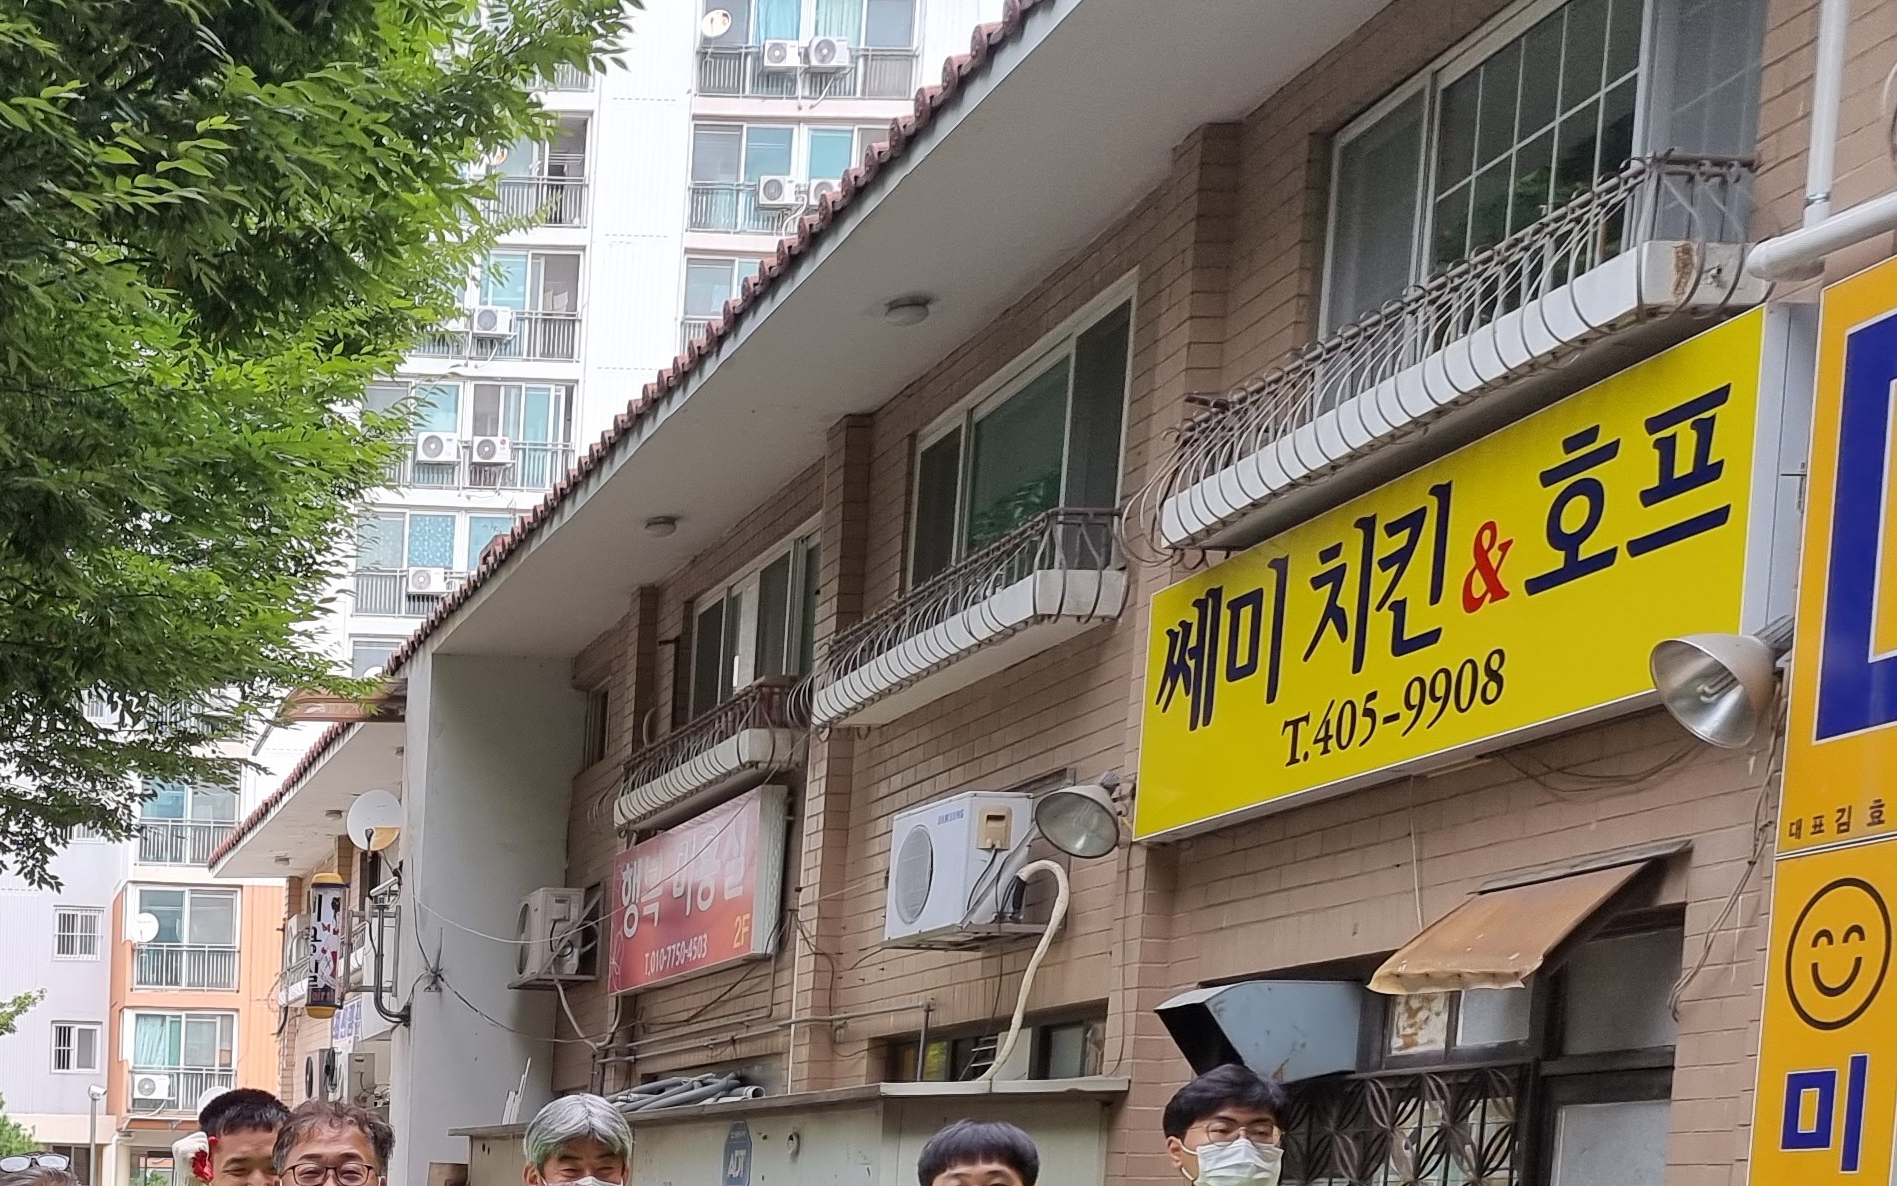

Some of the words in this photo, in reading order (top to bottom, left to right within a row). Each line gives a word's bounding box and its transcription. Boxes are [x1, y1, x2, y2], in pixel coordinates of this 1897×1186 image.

[1155, 555, 1289, 733] 쎄미
[1302, 483, 1455, 676] 치킨
[1462, 519, 1513, 615] &
[1523, 382, 1733, 598] 호프
[1280, 648, 1508, 769] T.405-9908
[1788, 814, 1826, 840] 대표
[620, 853, 665, 939] 행복
[672, 812, 750, 916] 미용실
[733, 912, 752, 949] 2F
[644, 932, 709, 977] T.010-7750-4503
[727, 1148, 747, 1179] ADT
